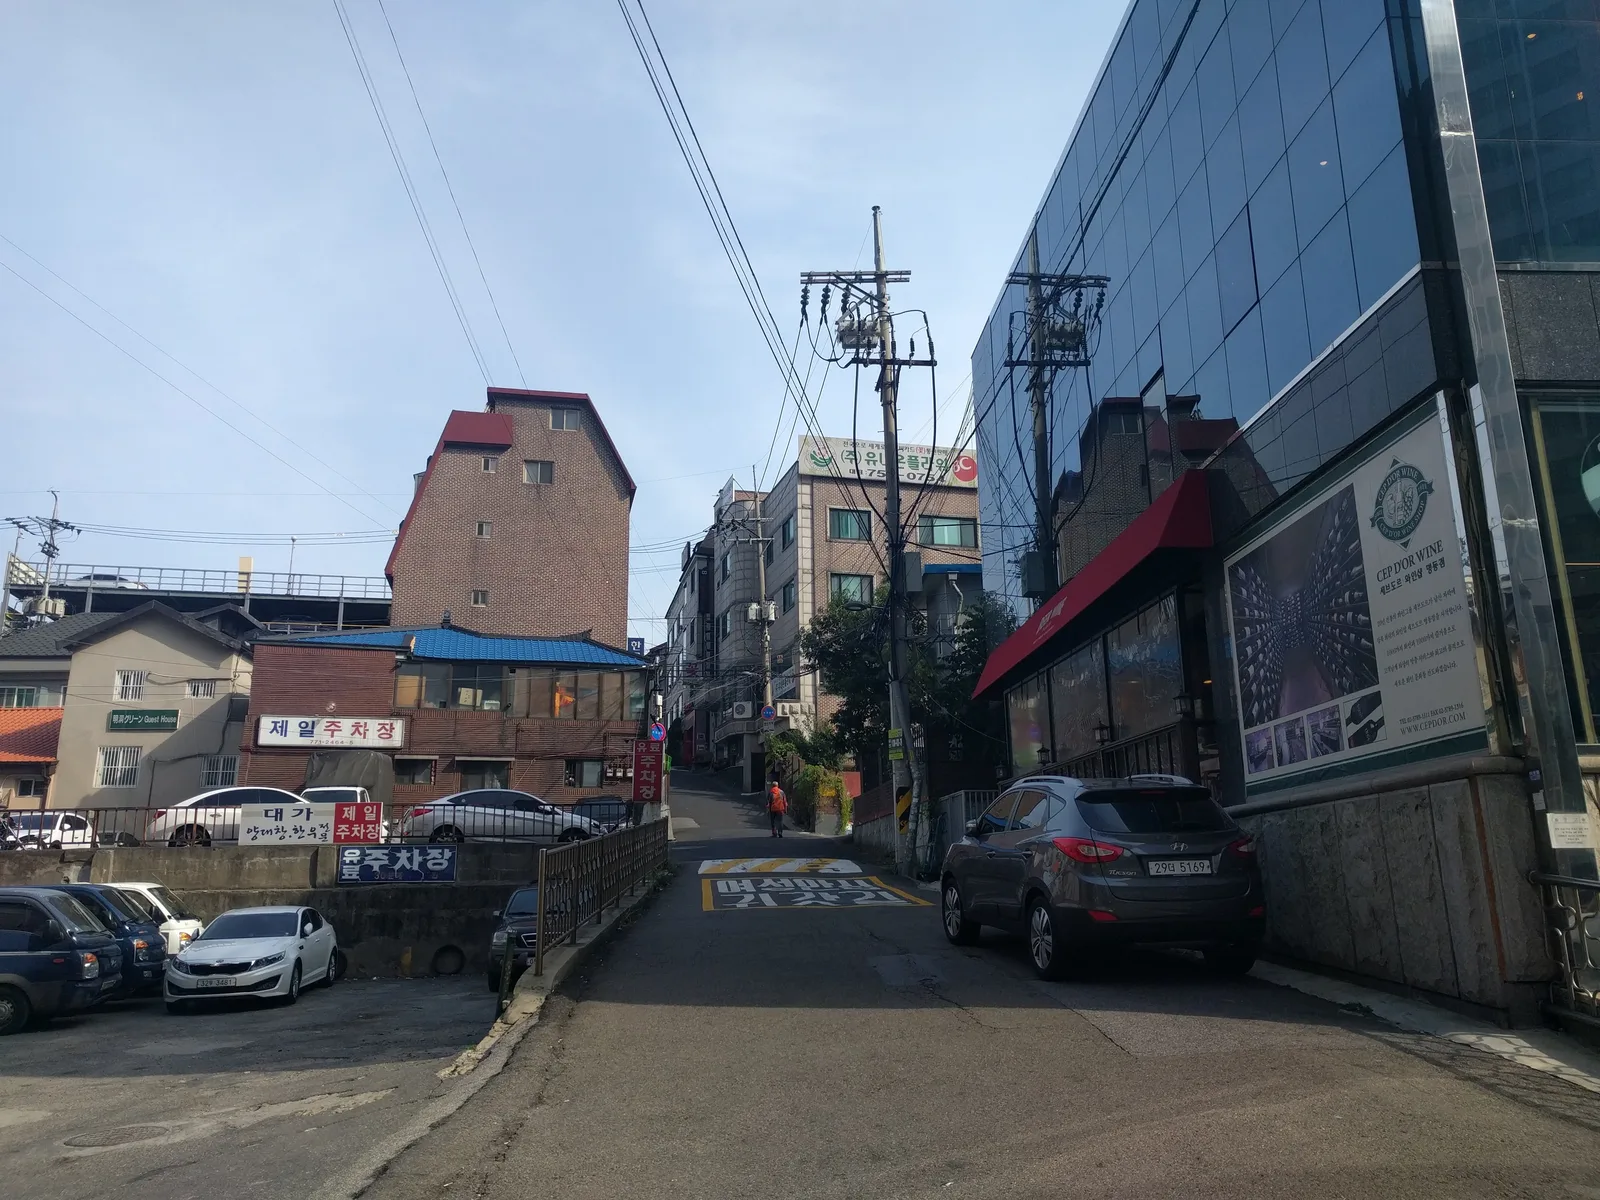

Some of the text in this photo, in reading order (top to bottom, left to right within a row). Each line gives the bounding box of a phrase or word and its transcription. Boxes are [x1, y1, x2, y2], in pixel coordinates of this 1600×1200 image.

[1376, 540, 1444, 582] CEP D'OR WINE
[160, 715, 176, 723] House
[1400, 712, 1466, 735] WWW.CEPDOR.COM
[636, 742, 660, 752] 유료
[640, 756, 656, 800] 주차장
[342, 806, 377, 821] 제일
[336, 824, 380, 840] 주차장
[342, 848, 452, 880] 유료 주차장
[1180, 862, 1204, 872] 5169
